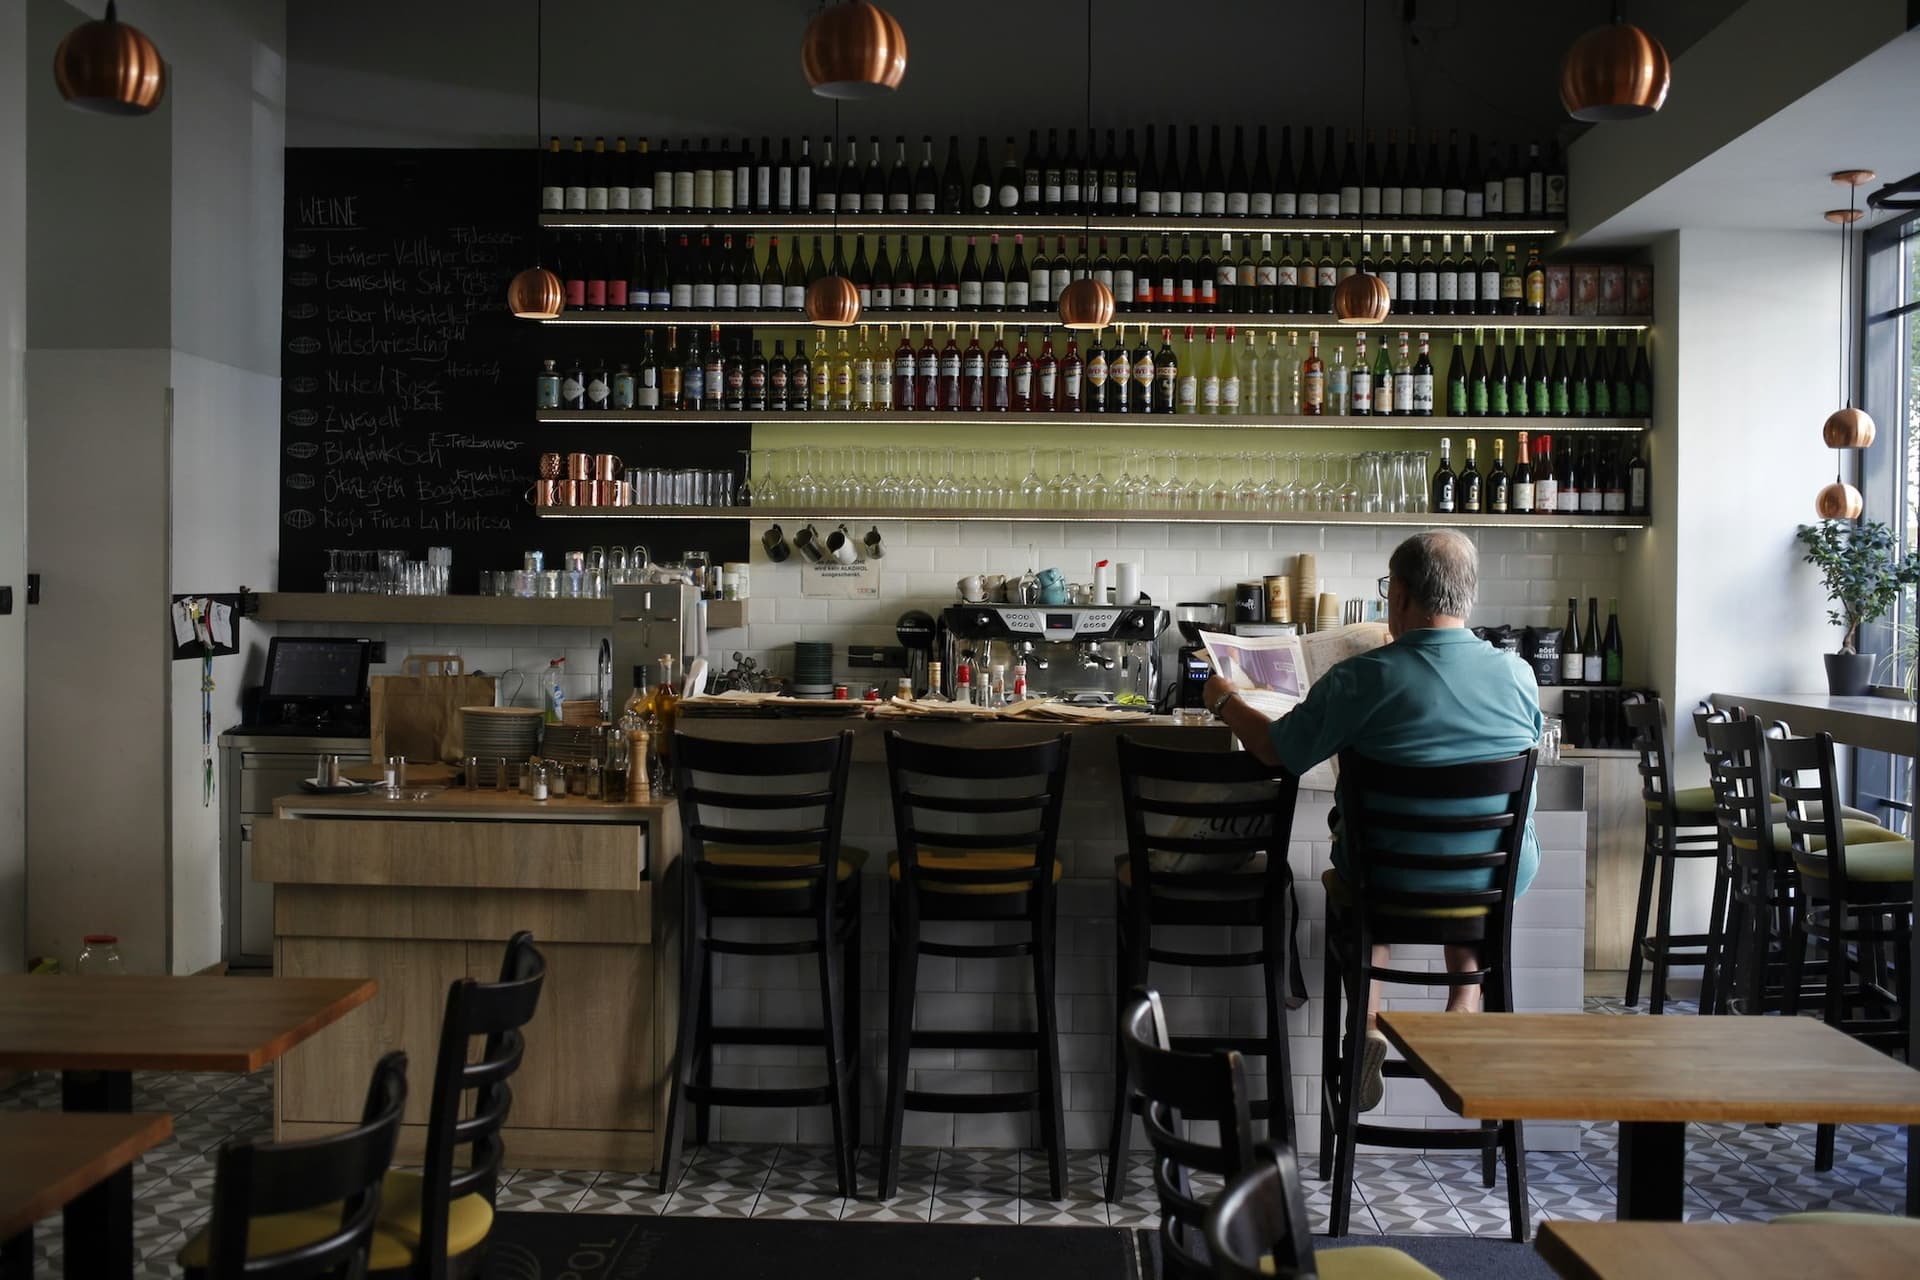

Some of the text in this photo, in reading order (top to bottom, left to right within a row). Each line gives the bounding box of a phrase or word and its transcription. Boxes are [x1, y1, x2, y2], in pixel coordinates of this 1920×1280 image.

[298, 195, 358, 226] WEINE
[1443, 484, 1452, 499] G
[1470, 485, 1478, 499] G
[1497, 485, 1505, 499] G
[319, 505, 364, 536] Rioja
[366, 506, 412, 529] Finca
[416, 506, 440, 530] La
